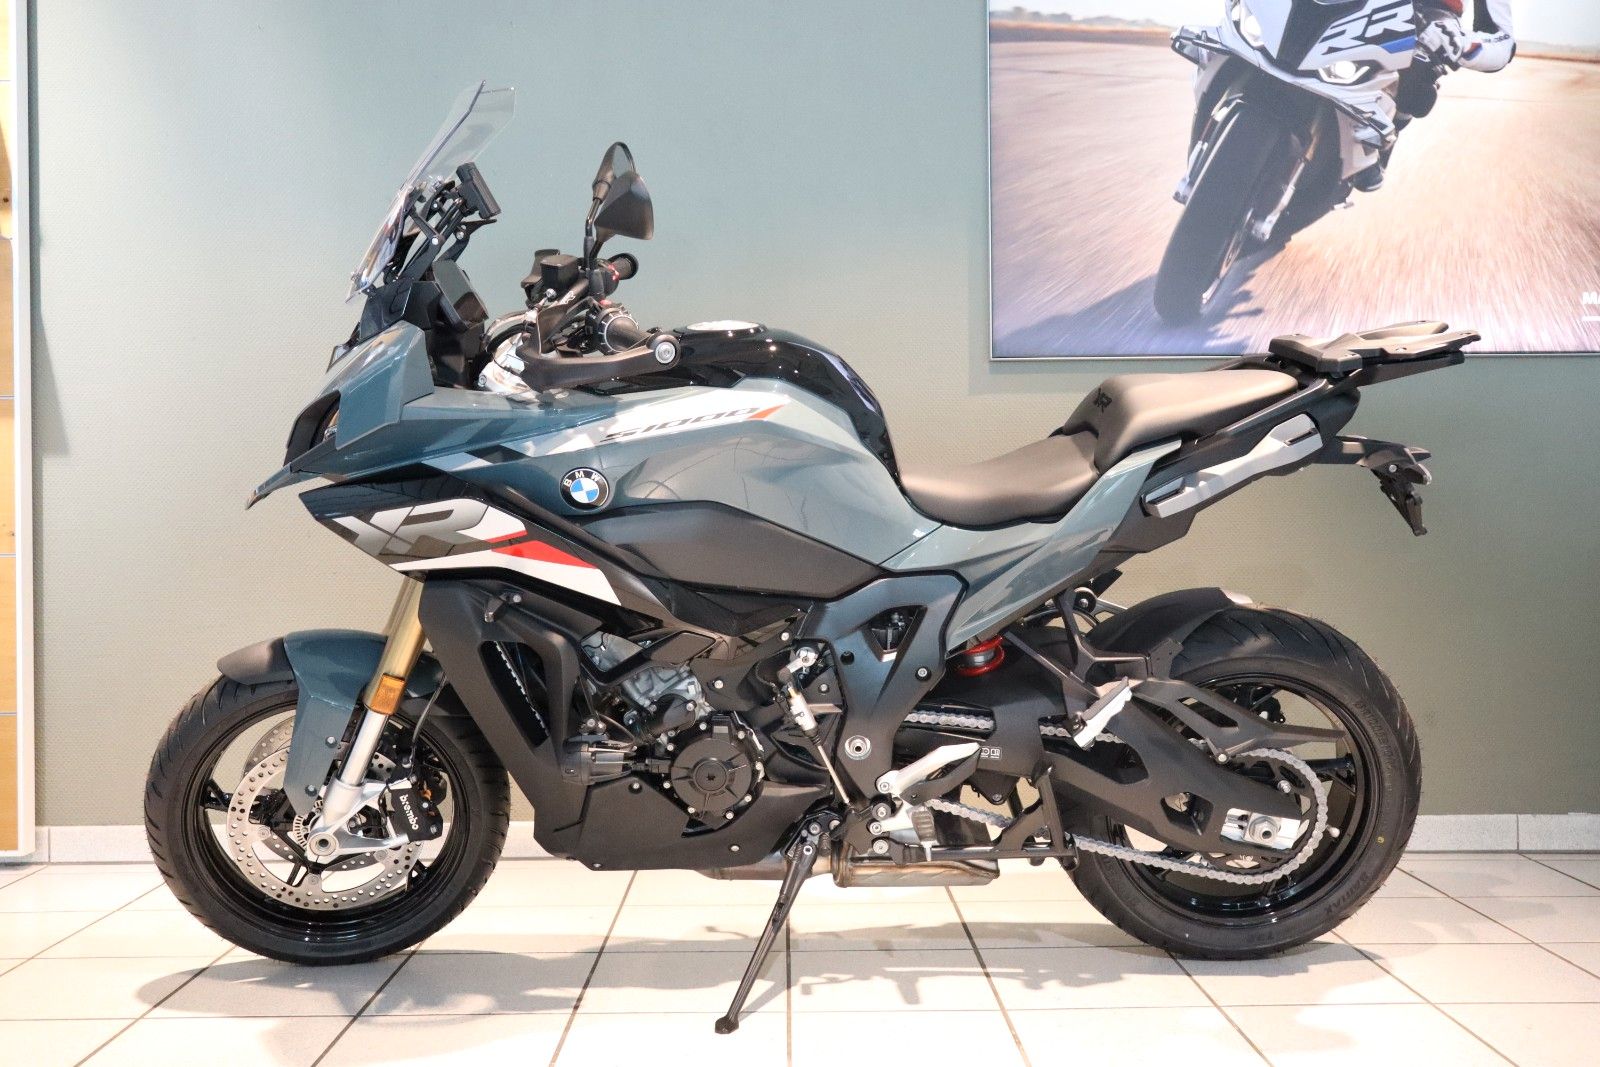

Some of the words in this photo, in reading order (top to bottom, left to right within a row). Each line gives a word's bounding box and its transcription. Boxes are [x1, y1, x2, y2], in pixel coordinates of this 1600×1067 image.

[600, 408, 760, 443] S1000
[563, 471, 601, 487] BMW
[332, 499, 490, 557] XR
[399, 793, 419, 830] brembo
